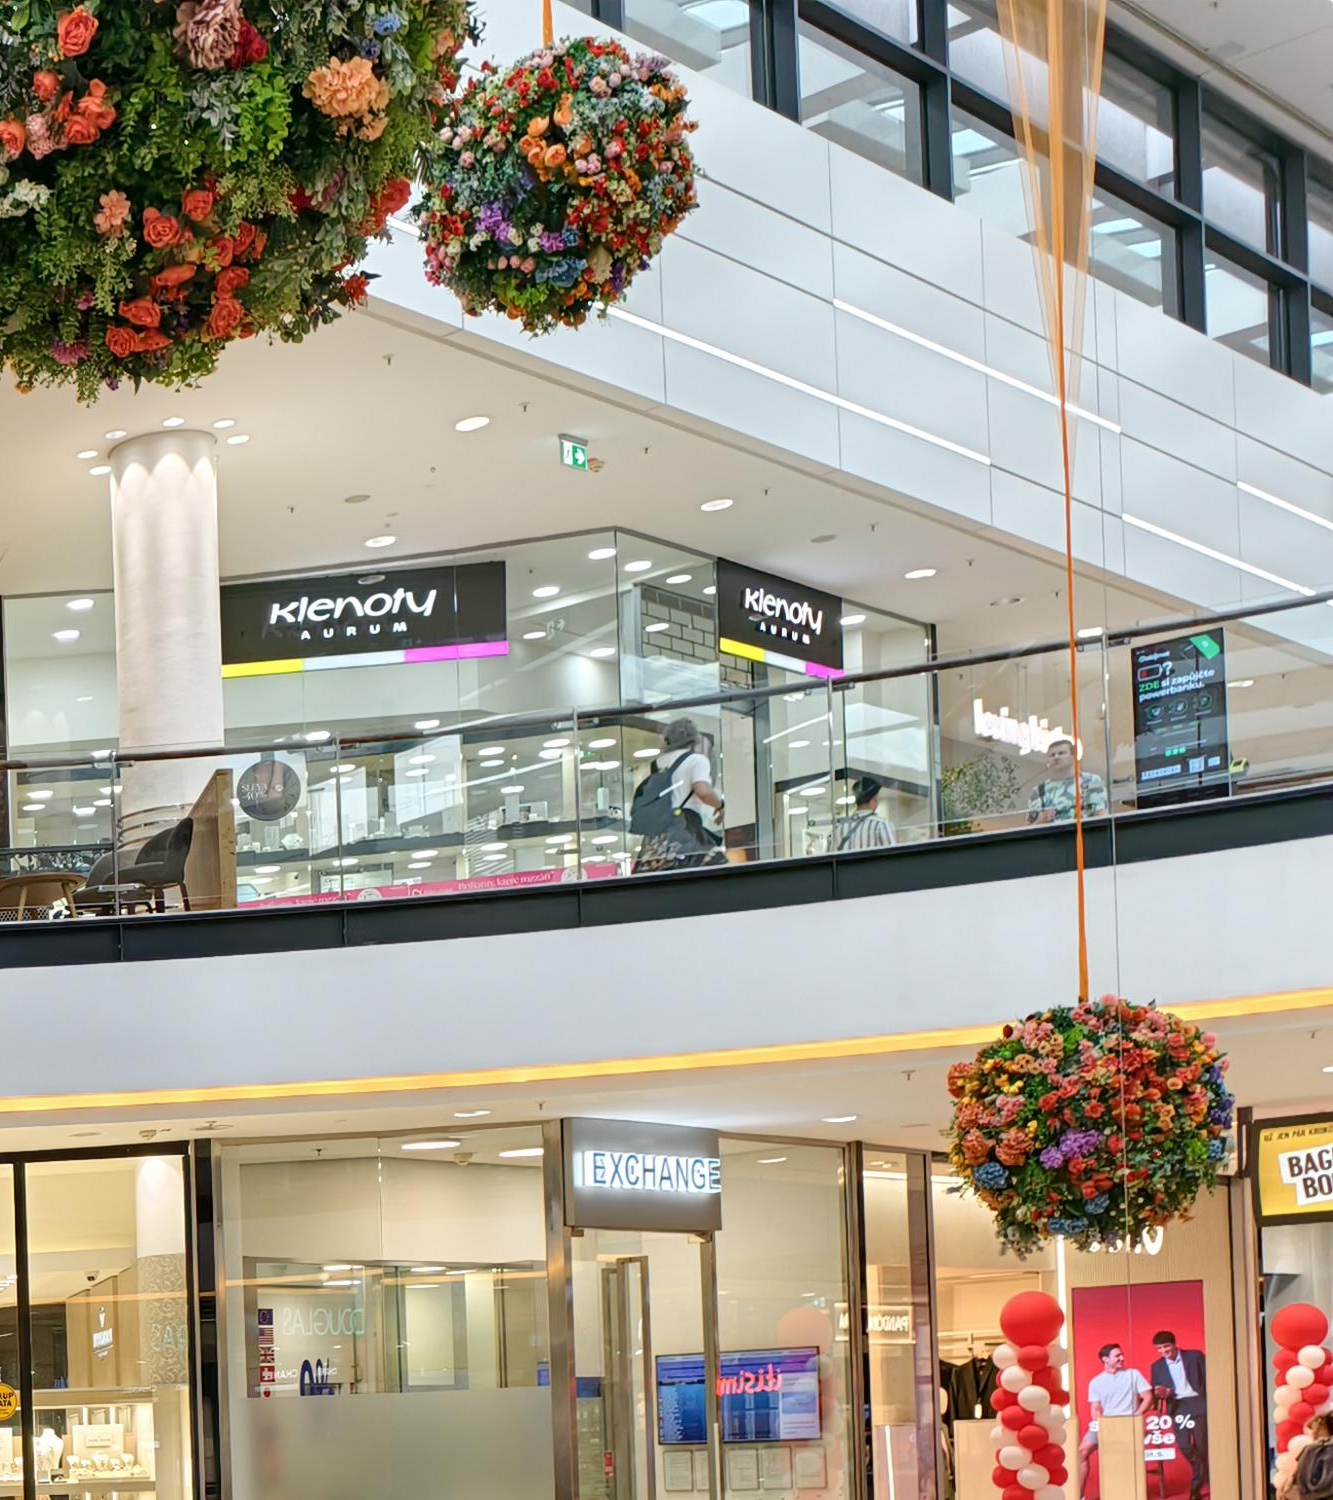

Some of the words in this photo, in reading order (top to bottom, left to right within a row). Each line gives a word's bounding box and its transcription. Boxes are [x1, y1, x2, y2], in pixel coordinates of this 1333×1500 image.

[300, 621, 408, 640] AURUM
[759, 621, 811, 645] AURUM
[592, 1151, 722, 1191] EXCHANGE
[1287, 1148, 1333, 1178] BAG
[1302, 1173, 1333, 1199] BO
